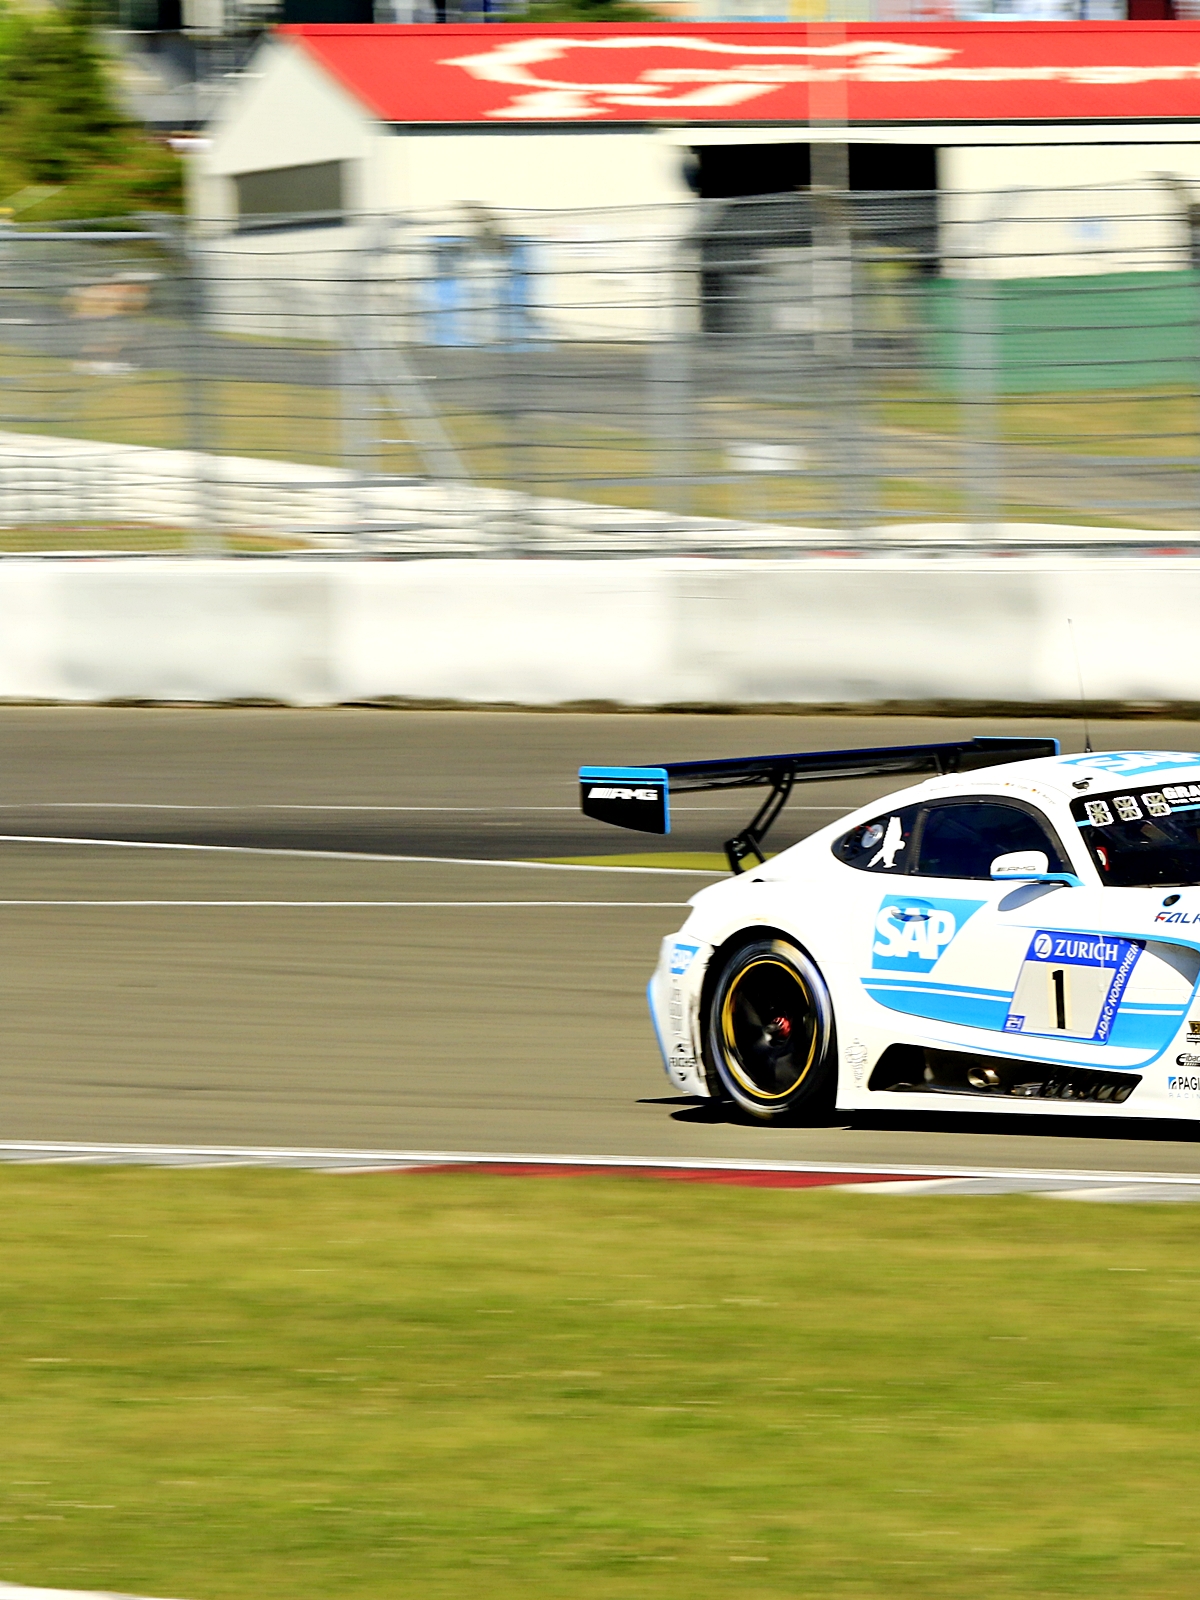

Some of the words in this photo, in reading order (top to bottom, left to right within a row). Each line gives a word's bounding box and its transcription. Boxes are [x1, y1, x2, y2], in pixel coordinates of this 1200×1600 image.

[872, 906, 956, 960] SAP
[1054, 939, 1118, 962] ZURICH
[1052, 969, 1066, 1029] 1
[1096, 1006, 1114, 1040] ADAC
[1108, 940, 1140, 1007] NORDRHEIN
